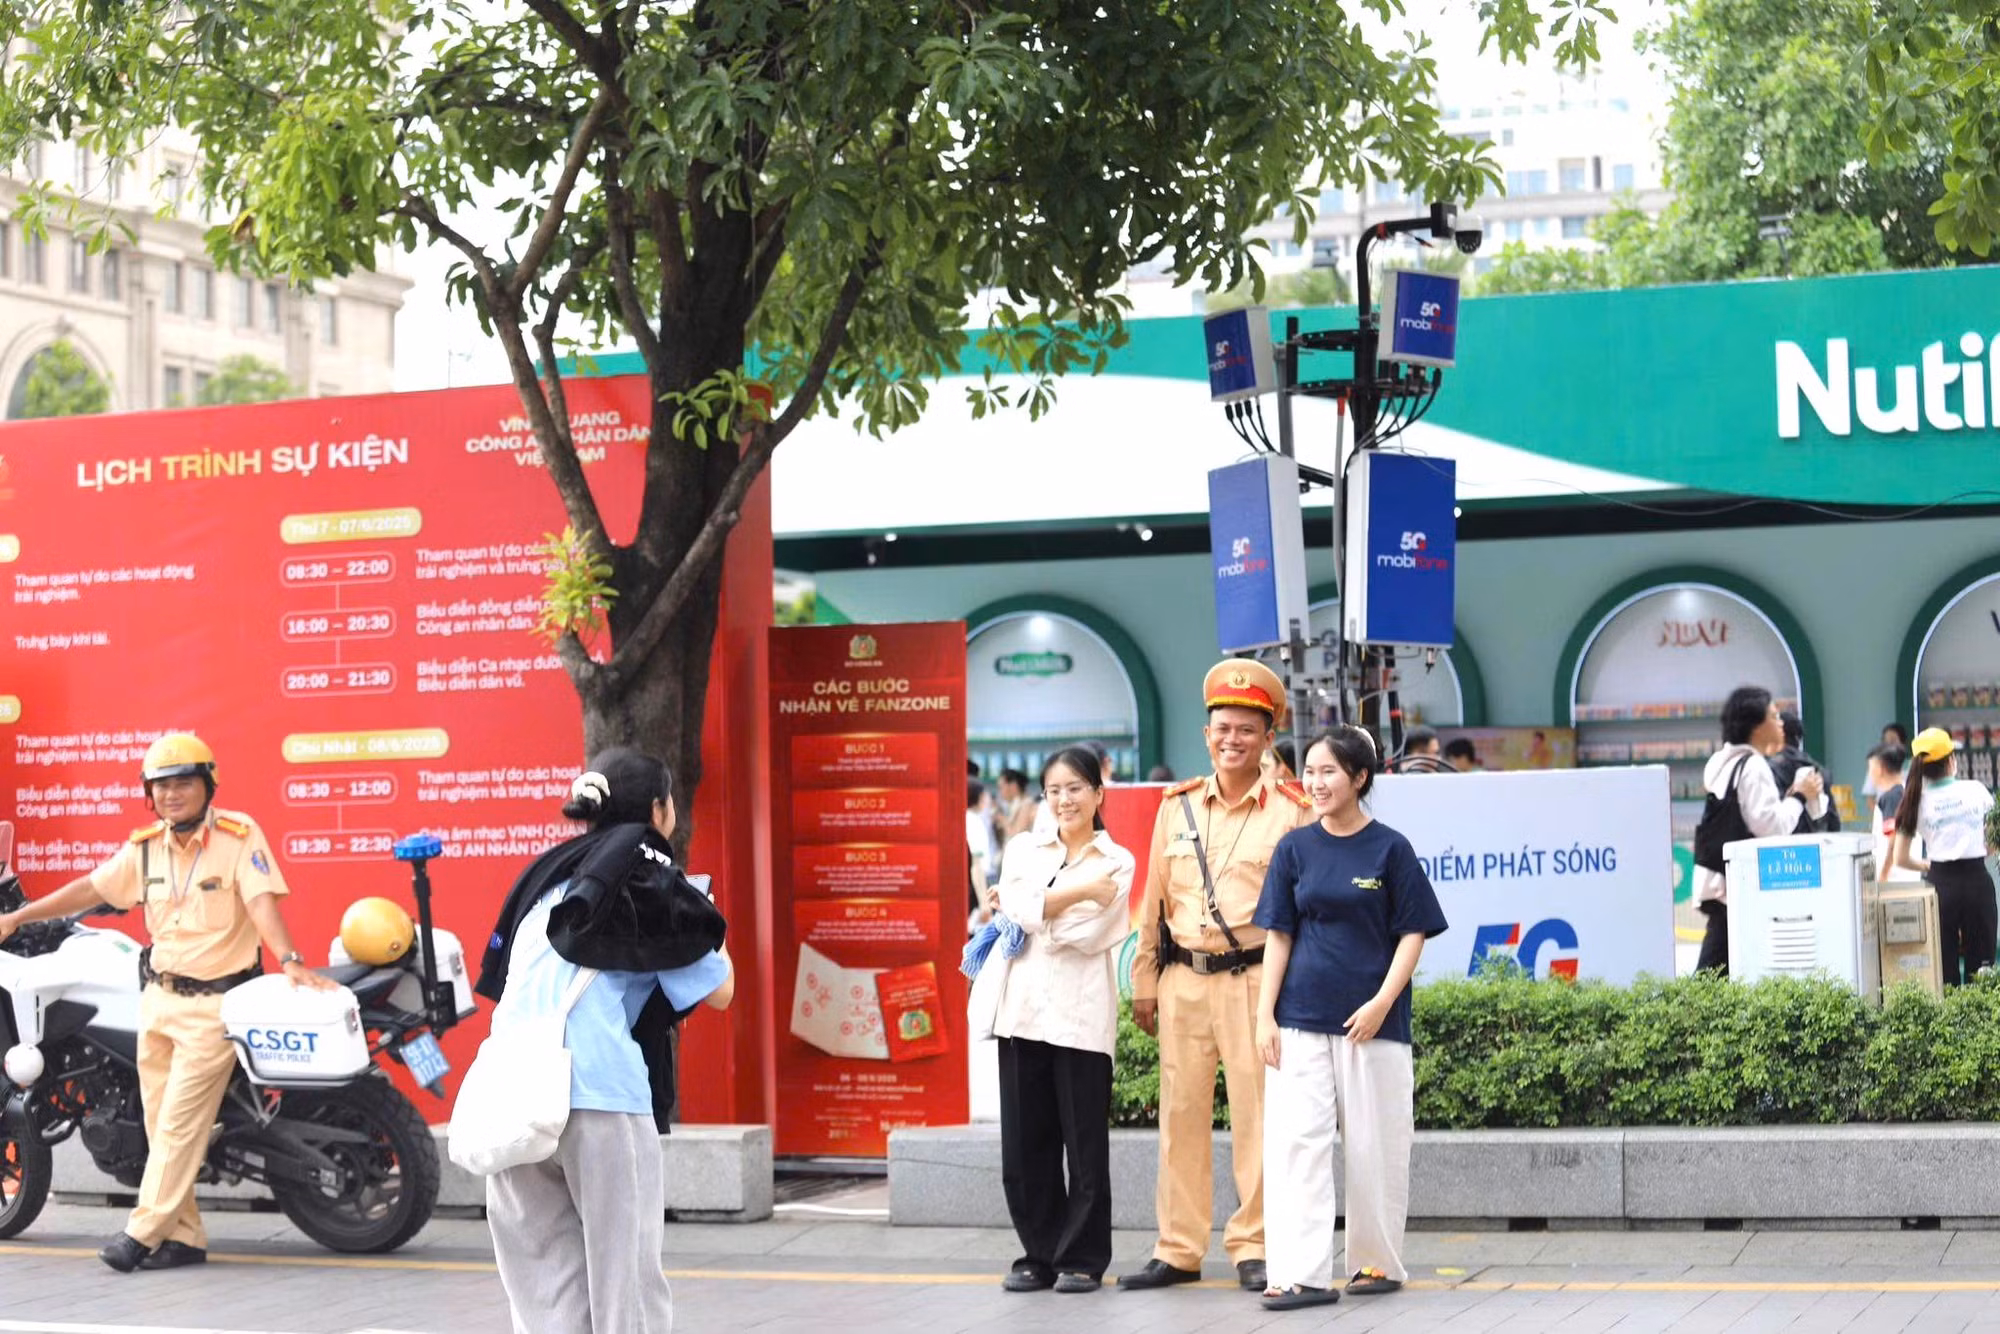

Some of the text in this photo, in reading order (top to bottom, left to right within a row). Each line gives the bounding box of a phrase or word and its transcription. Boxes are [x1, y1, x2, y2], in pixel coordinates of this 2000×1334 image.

[499, 416, 532, 433] VIN
[465, 434, 522, 453] CÔNG
[77, 433, 409, 492] LỊCH TRÌNH SỰ KIỆN
[514, 447, 546, 468] VIỆ
[1399, 531, 1427, 551] 5G
[416, 548, 452, 563] Tham
[455, 547, 488, 562] quan
[505, 543, 522, 556] do
[1377, 553, 1449, 570] mobifone
[347, 559, 390, 577] 22:00
[15, 572, 48, 587] Tham
[347, 613, 390, 632] 20:30
[416, 618, 452, 635] Công
[454, 620, 471, 633] an
[478, 657, 498, 673] Ca
[287, 672, 330, 690] 20:00
[813, 676, 909, 695] CÁC BƯỚC
[779, 697, 831, 716] NHẬN
[864, 695, 951, 712] FANZONE
[417, 770, 454, 785] Tham
[456, 769, 489, 785] quan
[506, 766, 524, 781] do
[350, 779, 391, 797] 12:00
[507, 823, 544, 840] VINH
[1483, 844, 1546, 879] PHÁT
[1553, 841, 1617, 875] SÓNG
